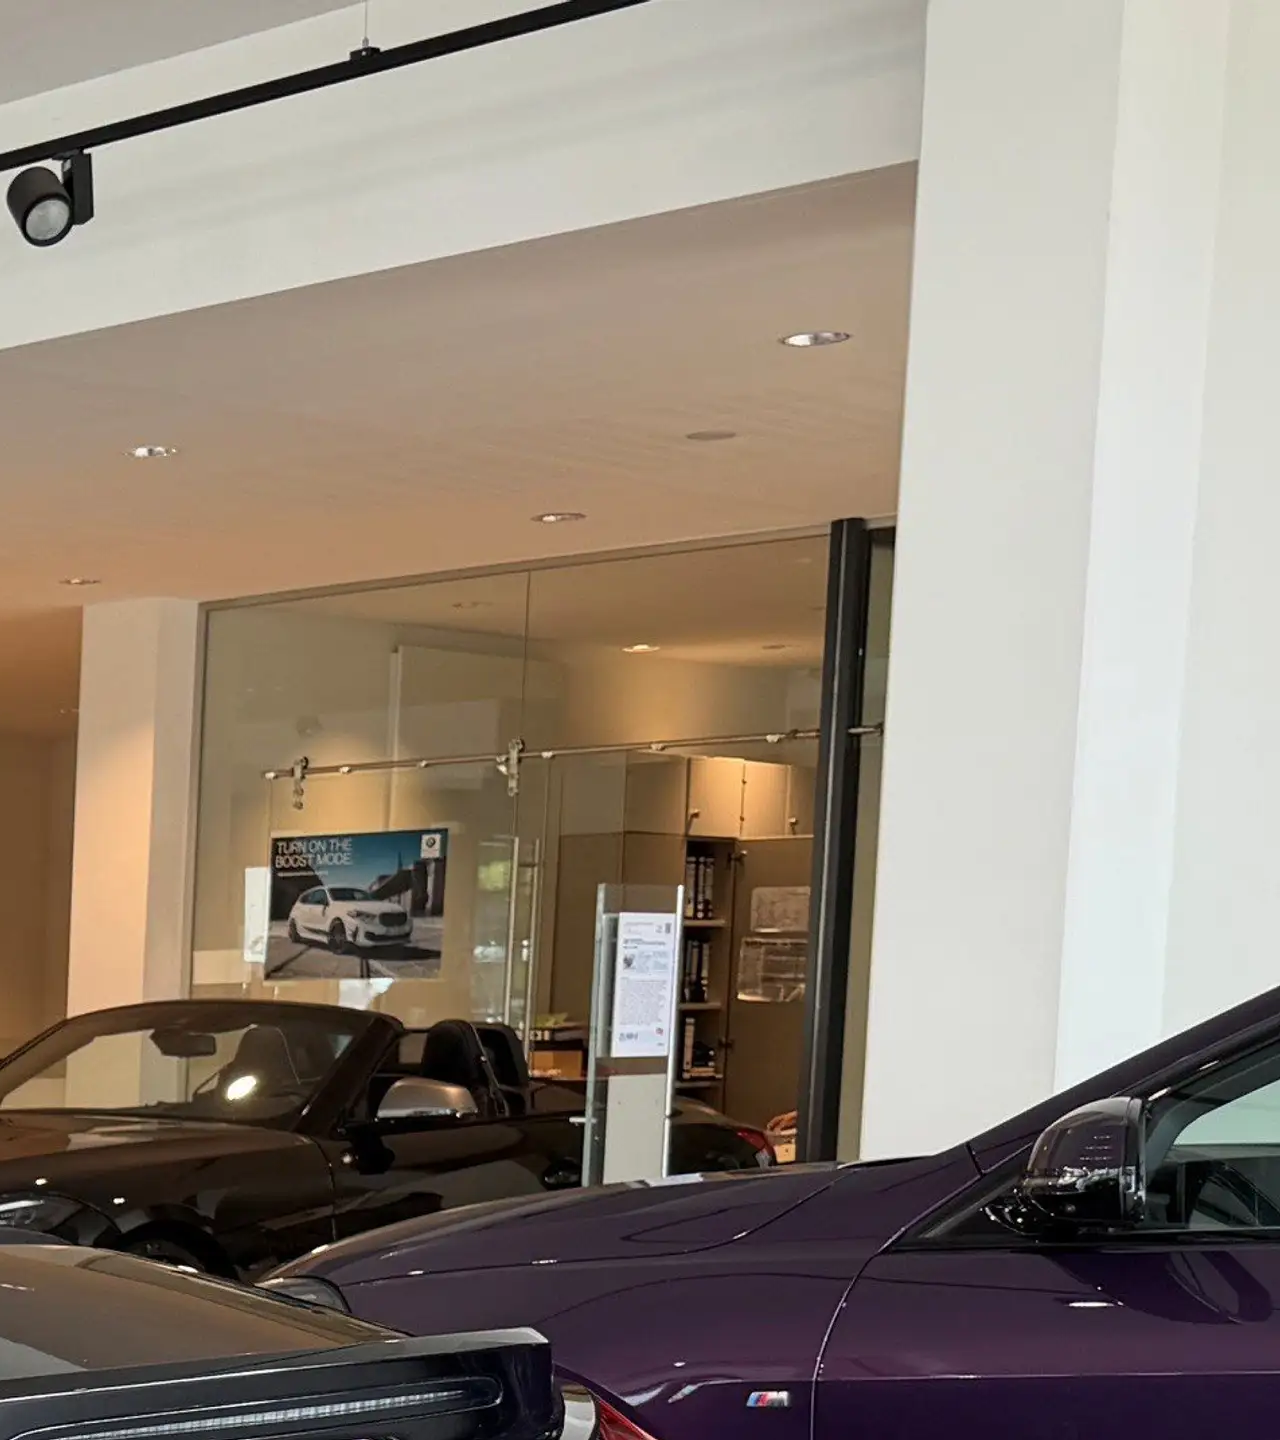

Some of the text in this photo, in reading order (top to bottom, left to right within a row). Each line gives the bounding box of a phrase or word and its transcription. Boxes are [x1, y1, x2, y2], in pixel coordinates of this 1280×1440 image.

[277, 837, 352, 854] TURN ON THE
[275, 854, 315, 868] BOOST
